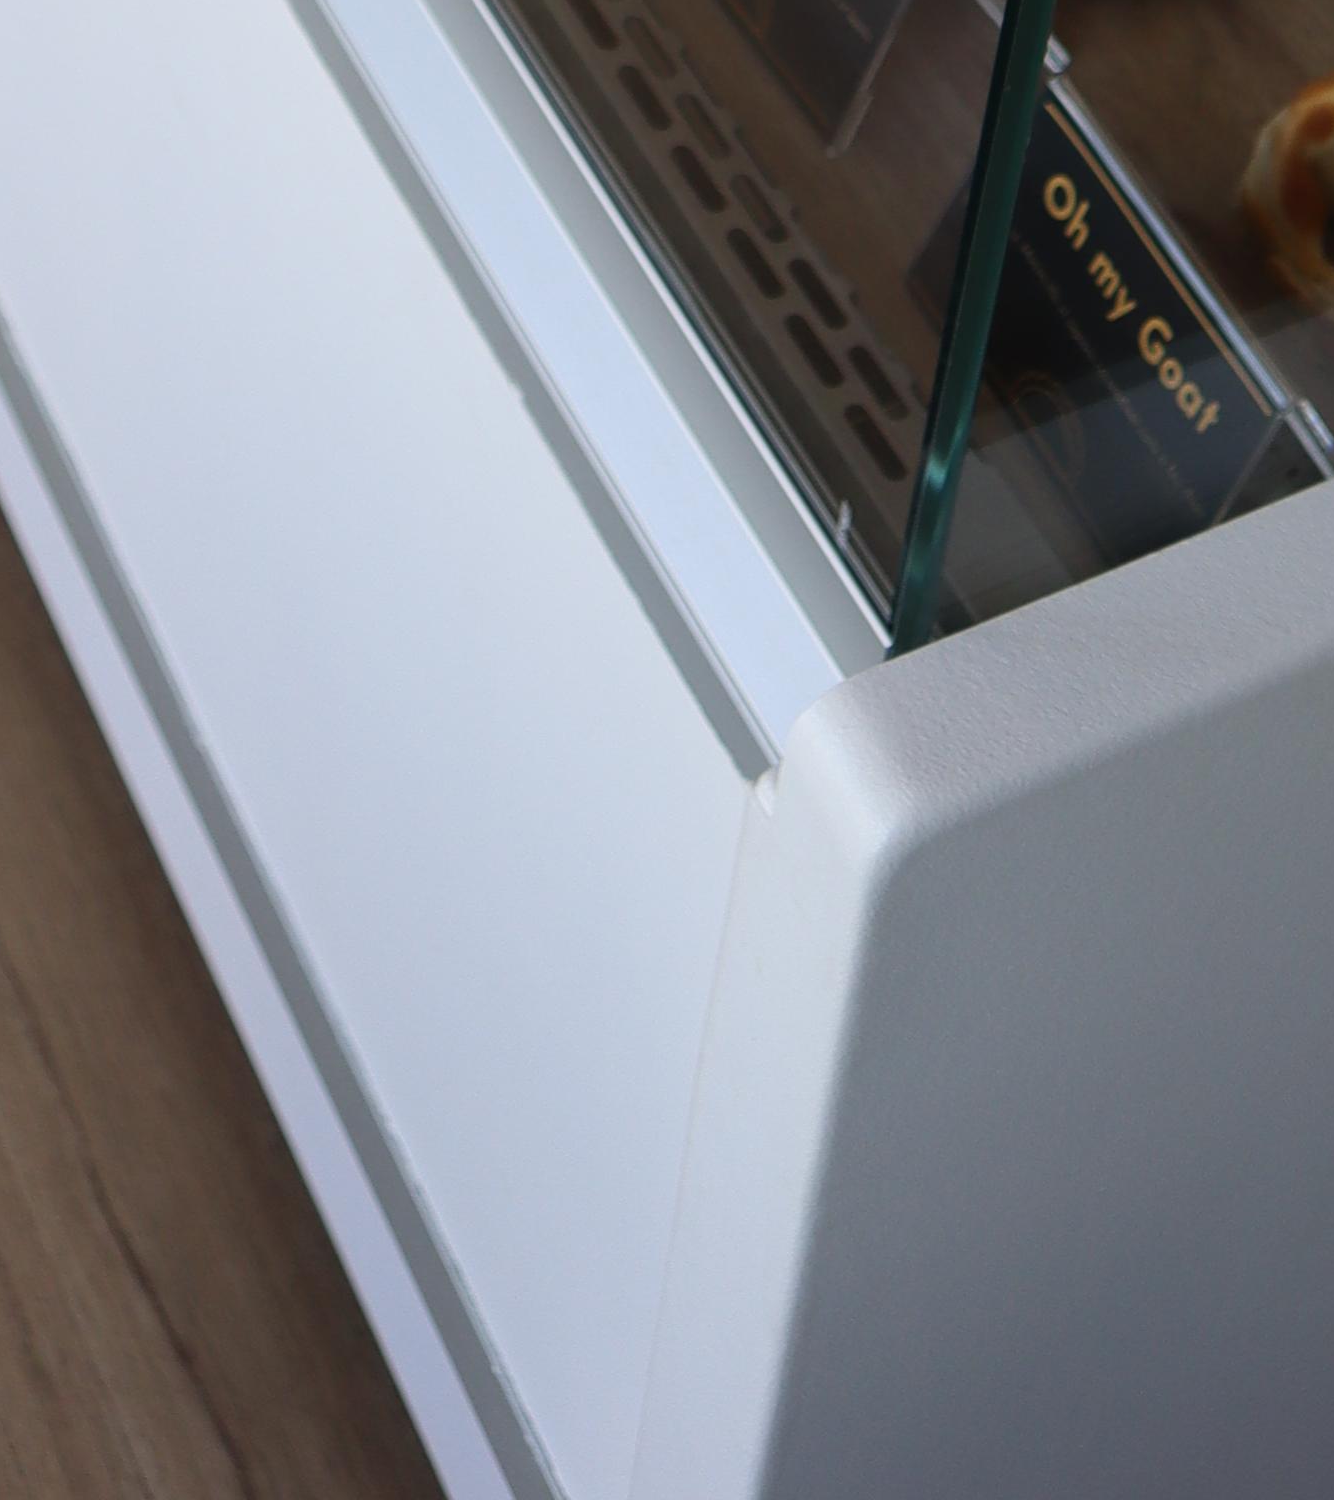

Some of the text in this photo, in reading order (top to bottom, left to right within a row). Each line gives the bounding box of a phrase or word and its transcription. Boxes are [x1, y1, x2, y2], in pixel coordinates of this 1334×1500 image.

[1043, 172, 1220, 435] Oh my Goat
